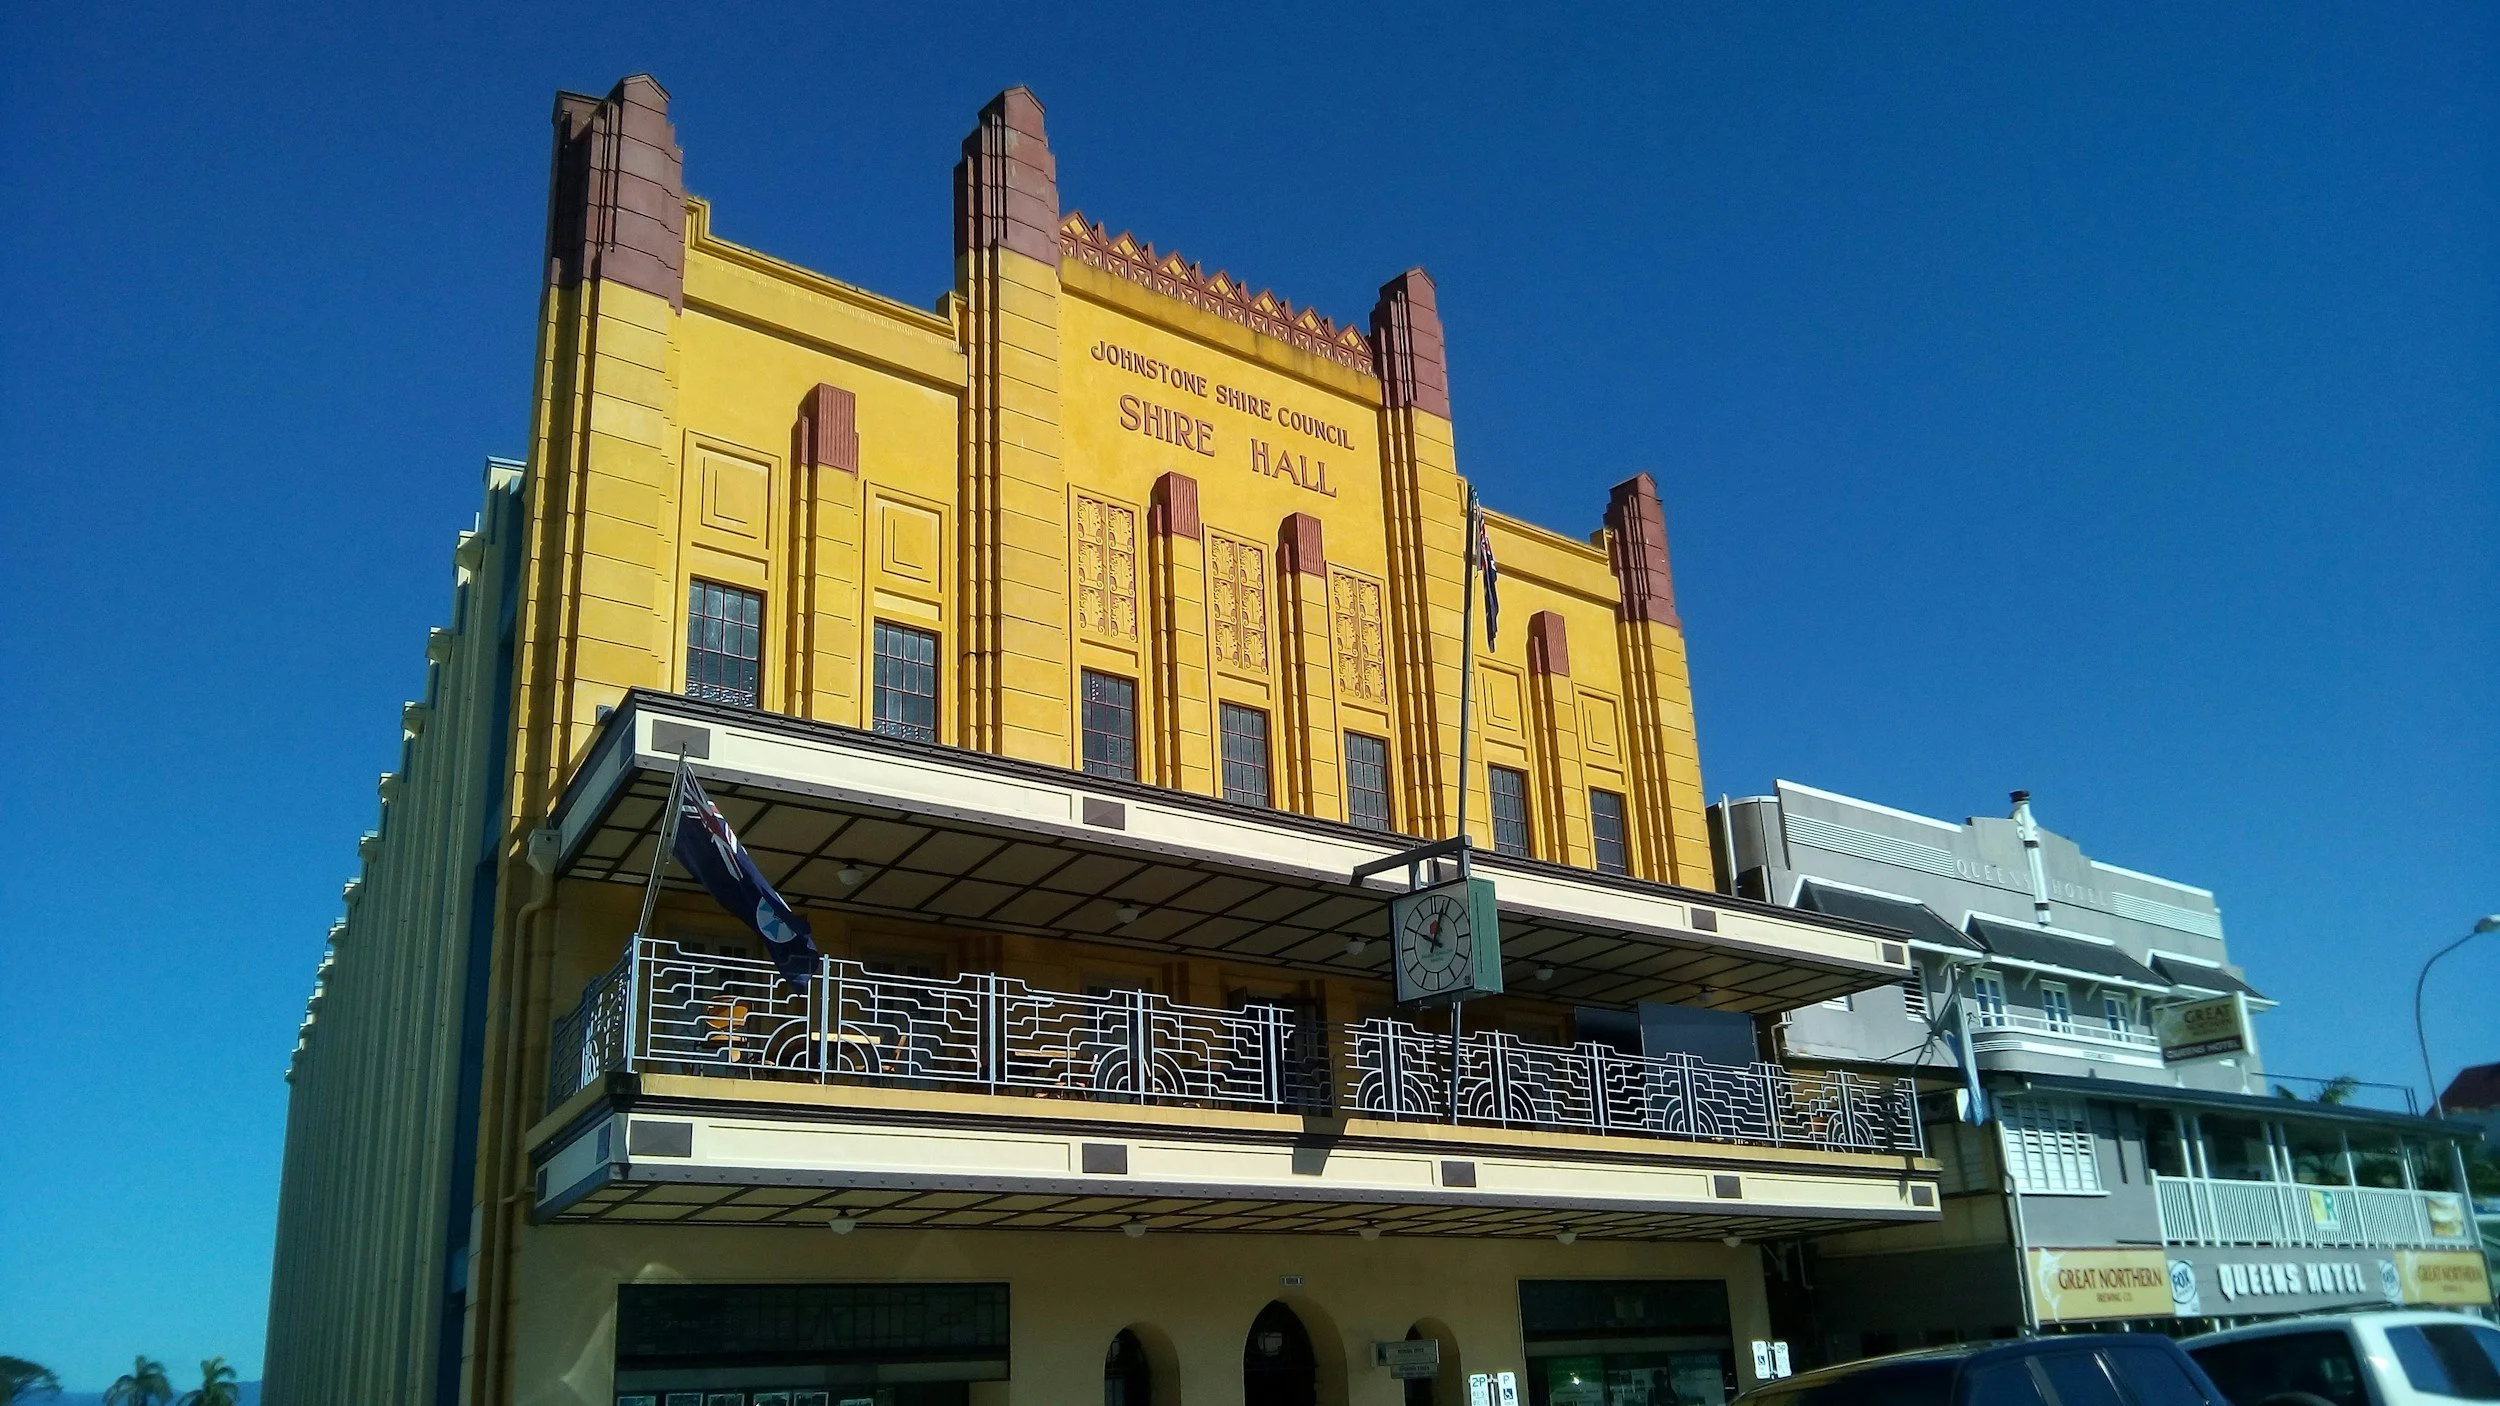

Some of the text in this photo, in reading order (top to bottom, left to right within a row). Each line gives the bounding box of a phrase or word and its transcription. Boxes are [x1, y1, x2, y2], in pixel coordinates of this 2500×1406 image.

[1090, 340, 1355, 451] JOHNSTONE SHIRE COUNCIL
[1119, 394, 1337, 498] SHIRE HALL
[1956, 859, 2031, 889] QUEENS
[2058, 1267, 2163, 1290] GREAT NORTHERN
[2217, 1263, 2366, 1301] QUEENS HOTEL
[1472, 1377, 1485, 1387] 2P
[1503, 1375, 1509, 1384] P
